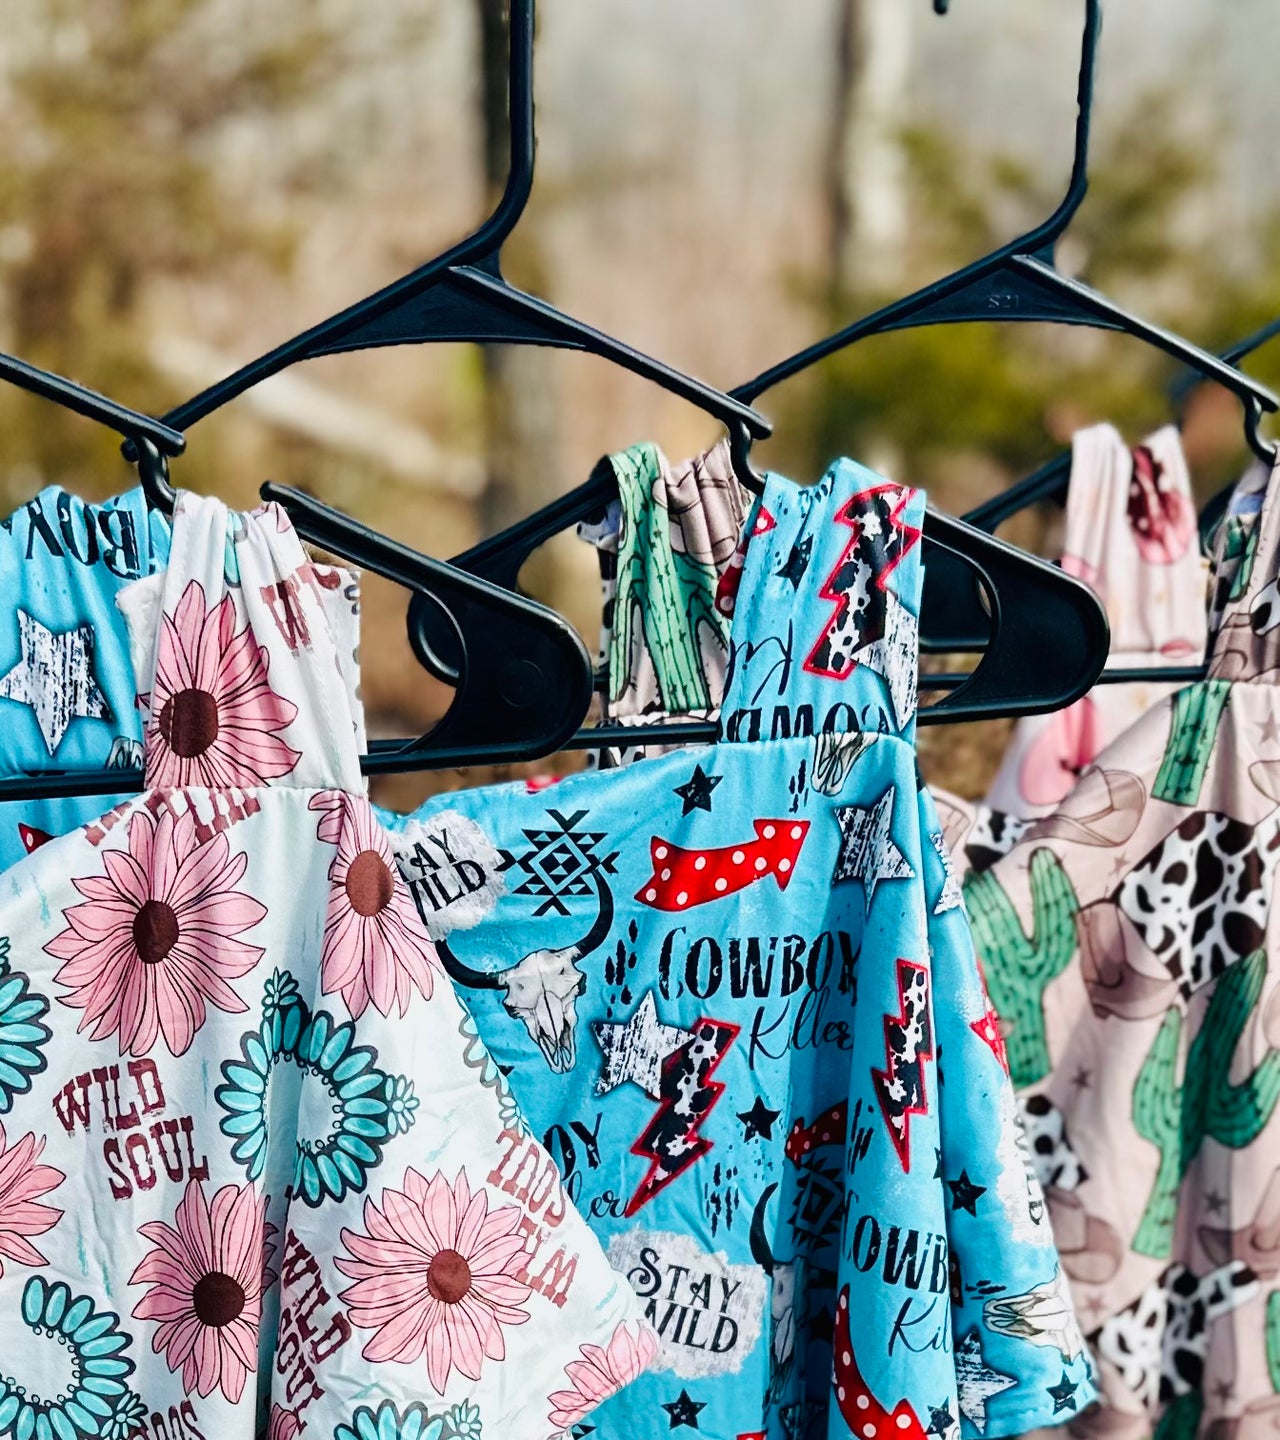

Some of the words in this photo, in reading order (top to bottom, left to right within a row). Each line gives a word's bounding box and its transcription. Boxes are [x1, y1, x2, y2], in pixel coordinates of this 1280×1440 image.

[658, 926, 861, 1005] COWBOY
[52, 1058, 166, 1137] WILD
[103, 1116, 210, 1201] SOUL
[627, 1247, 741, 1315] STAY
